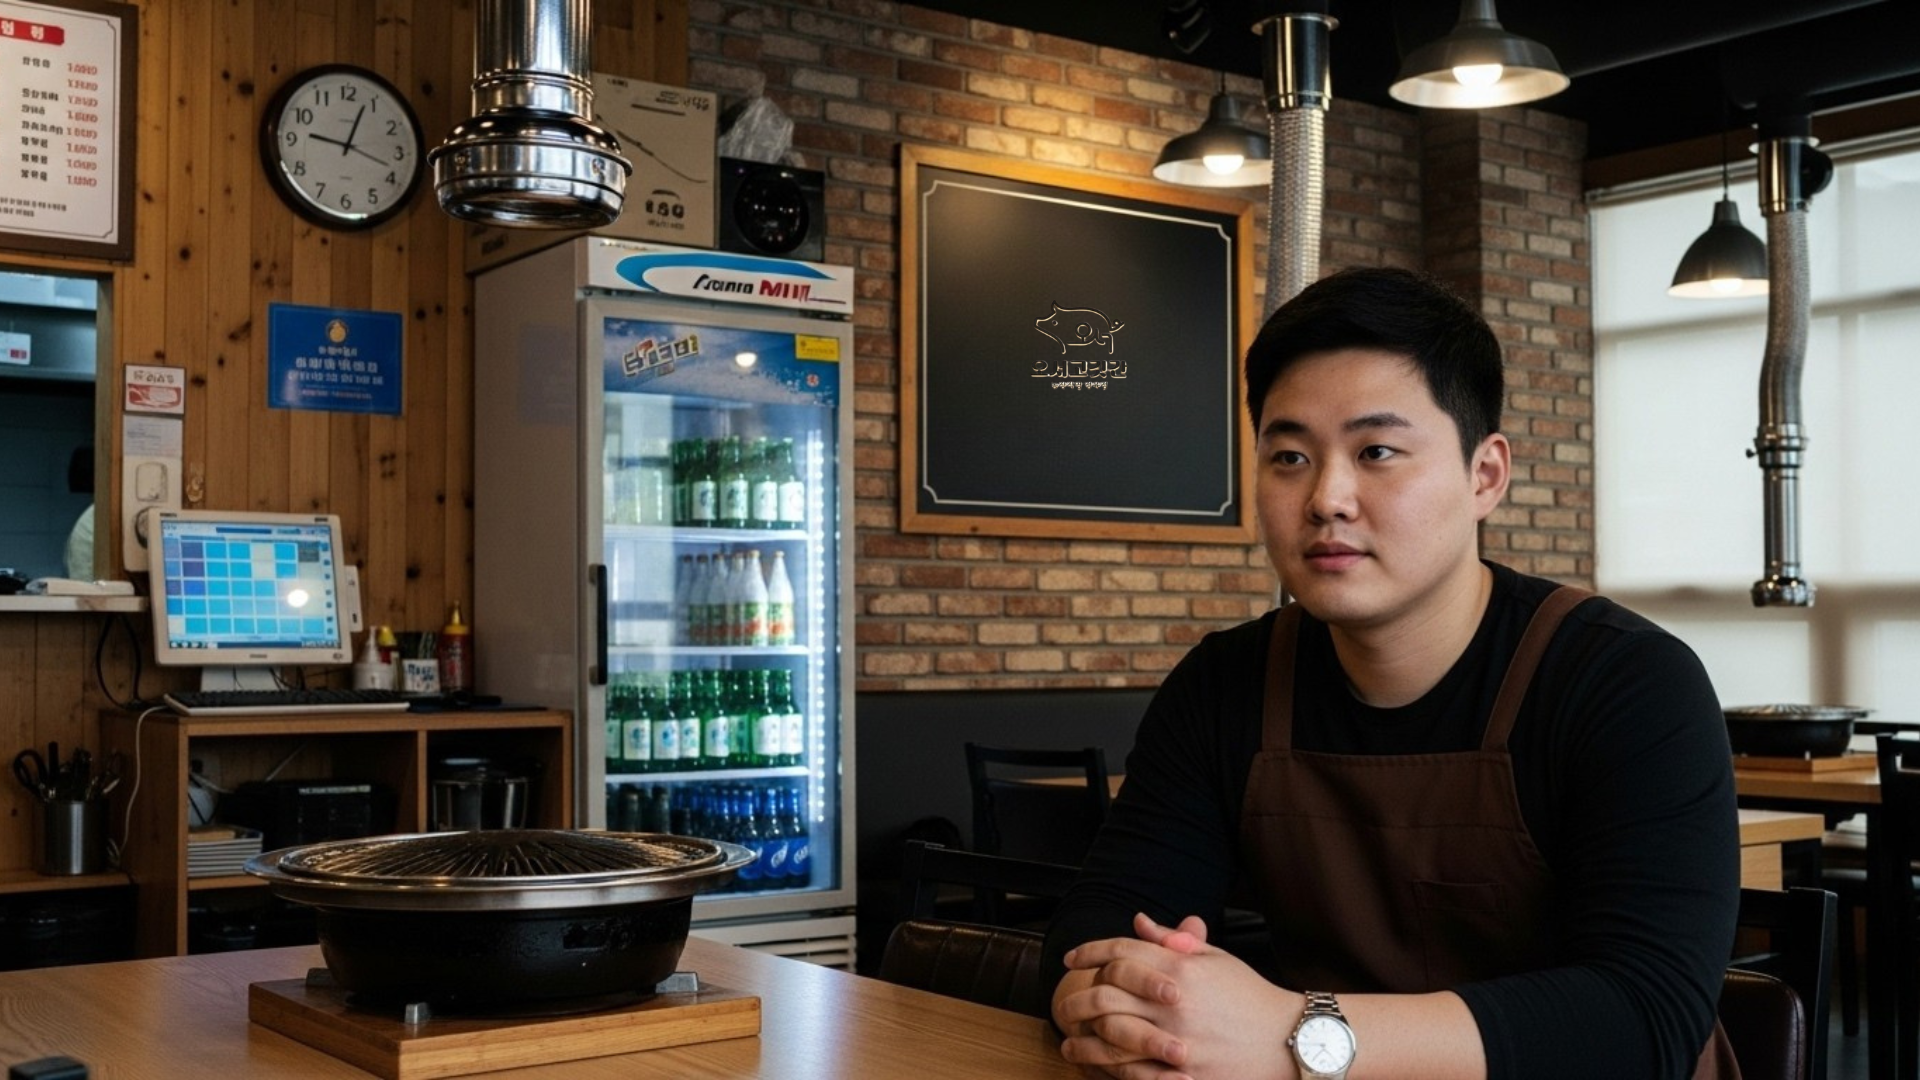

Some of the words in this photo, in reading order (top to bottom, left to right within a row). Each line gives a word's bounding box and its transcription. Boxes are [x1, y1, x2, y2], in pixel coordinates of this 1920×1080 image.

[315, 89, 329, 106] 11
[340, 85, 357, 102] 12
[370, 98, 377, 113] 1
[295, 108, 314, 125] 10
[386, 121, 398, 136] 2
[286, 132, 298, 146] 9
[393, 146, 404, 160] 3
[293, 161, 307, 176] 8
[385, 172, 396, 185] 4
[315, 182, 326, 198] 7
[368, 188, 378, 204] 5
[340, 194, 352, 209] 6
[1031, 360, 1128, 379] 오서고깃간
